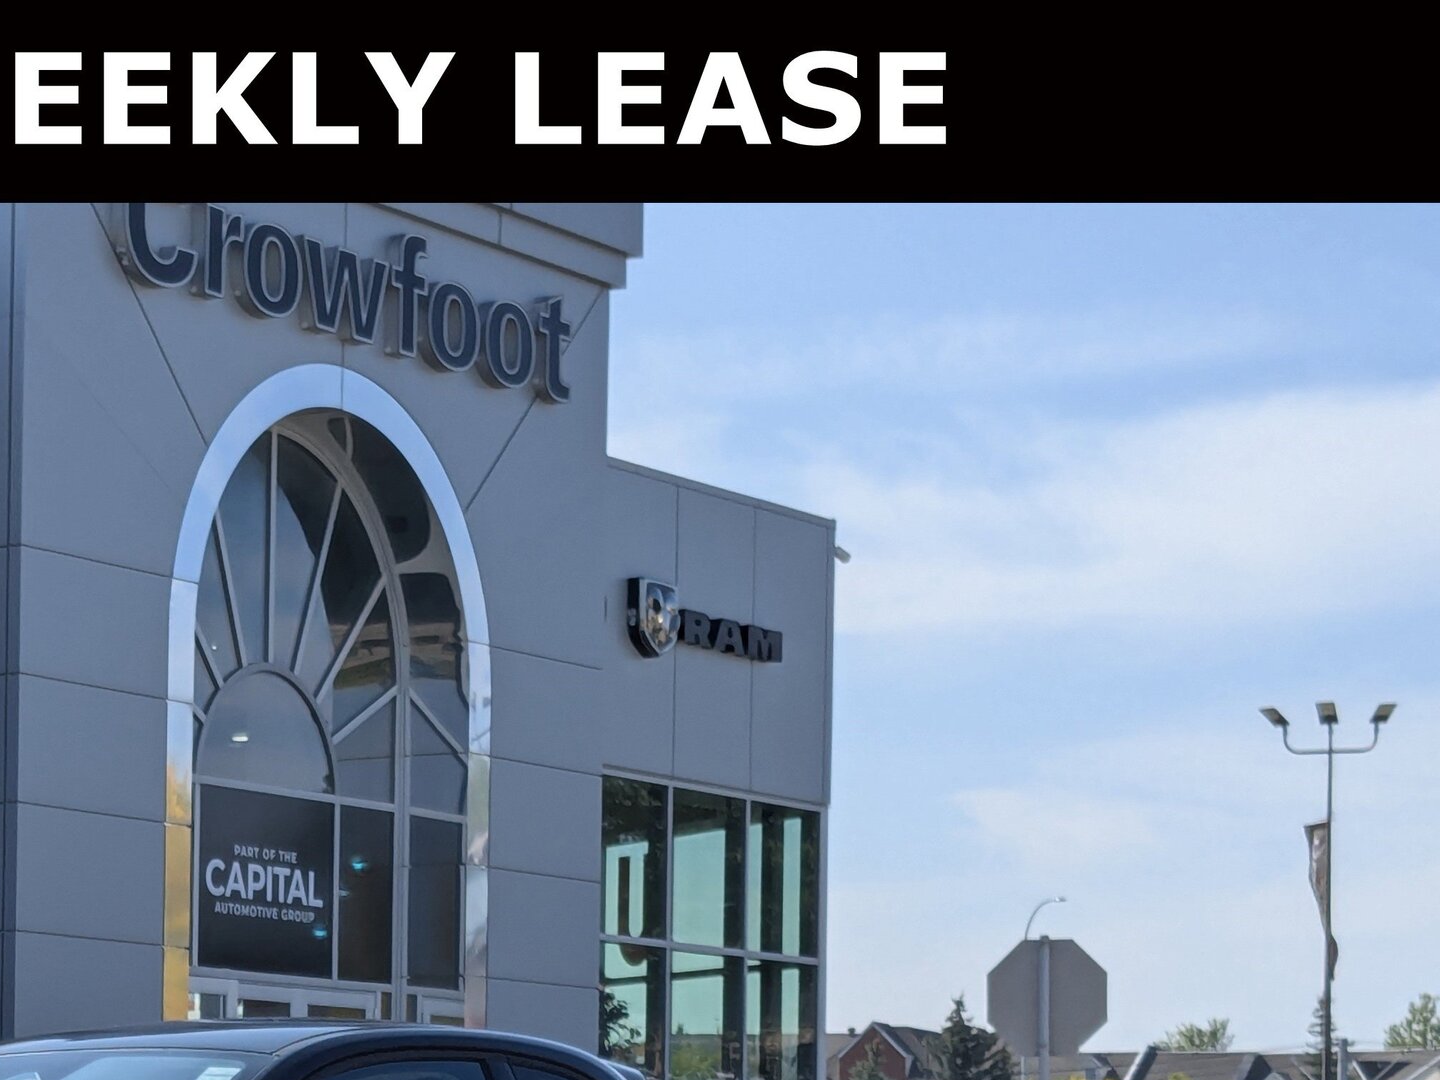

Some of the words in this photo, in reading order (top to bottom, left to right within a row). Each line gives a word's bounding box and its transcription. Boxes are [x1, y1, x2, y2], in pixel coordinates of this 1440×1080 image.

[126, 203, 571, 403] Crowfoot
[678, 608, 783, 663] RAM
[234, 844, 260, 859] PART
[262, 848, 276, 861] OF
[279, 850, 298, 864] THE
[205, 858, 324, 908] CAPITAL
[214, 901, 279, 920] AUTOMOTIVE
[280, 908, 315, 923] GROUP
